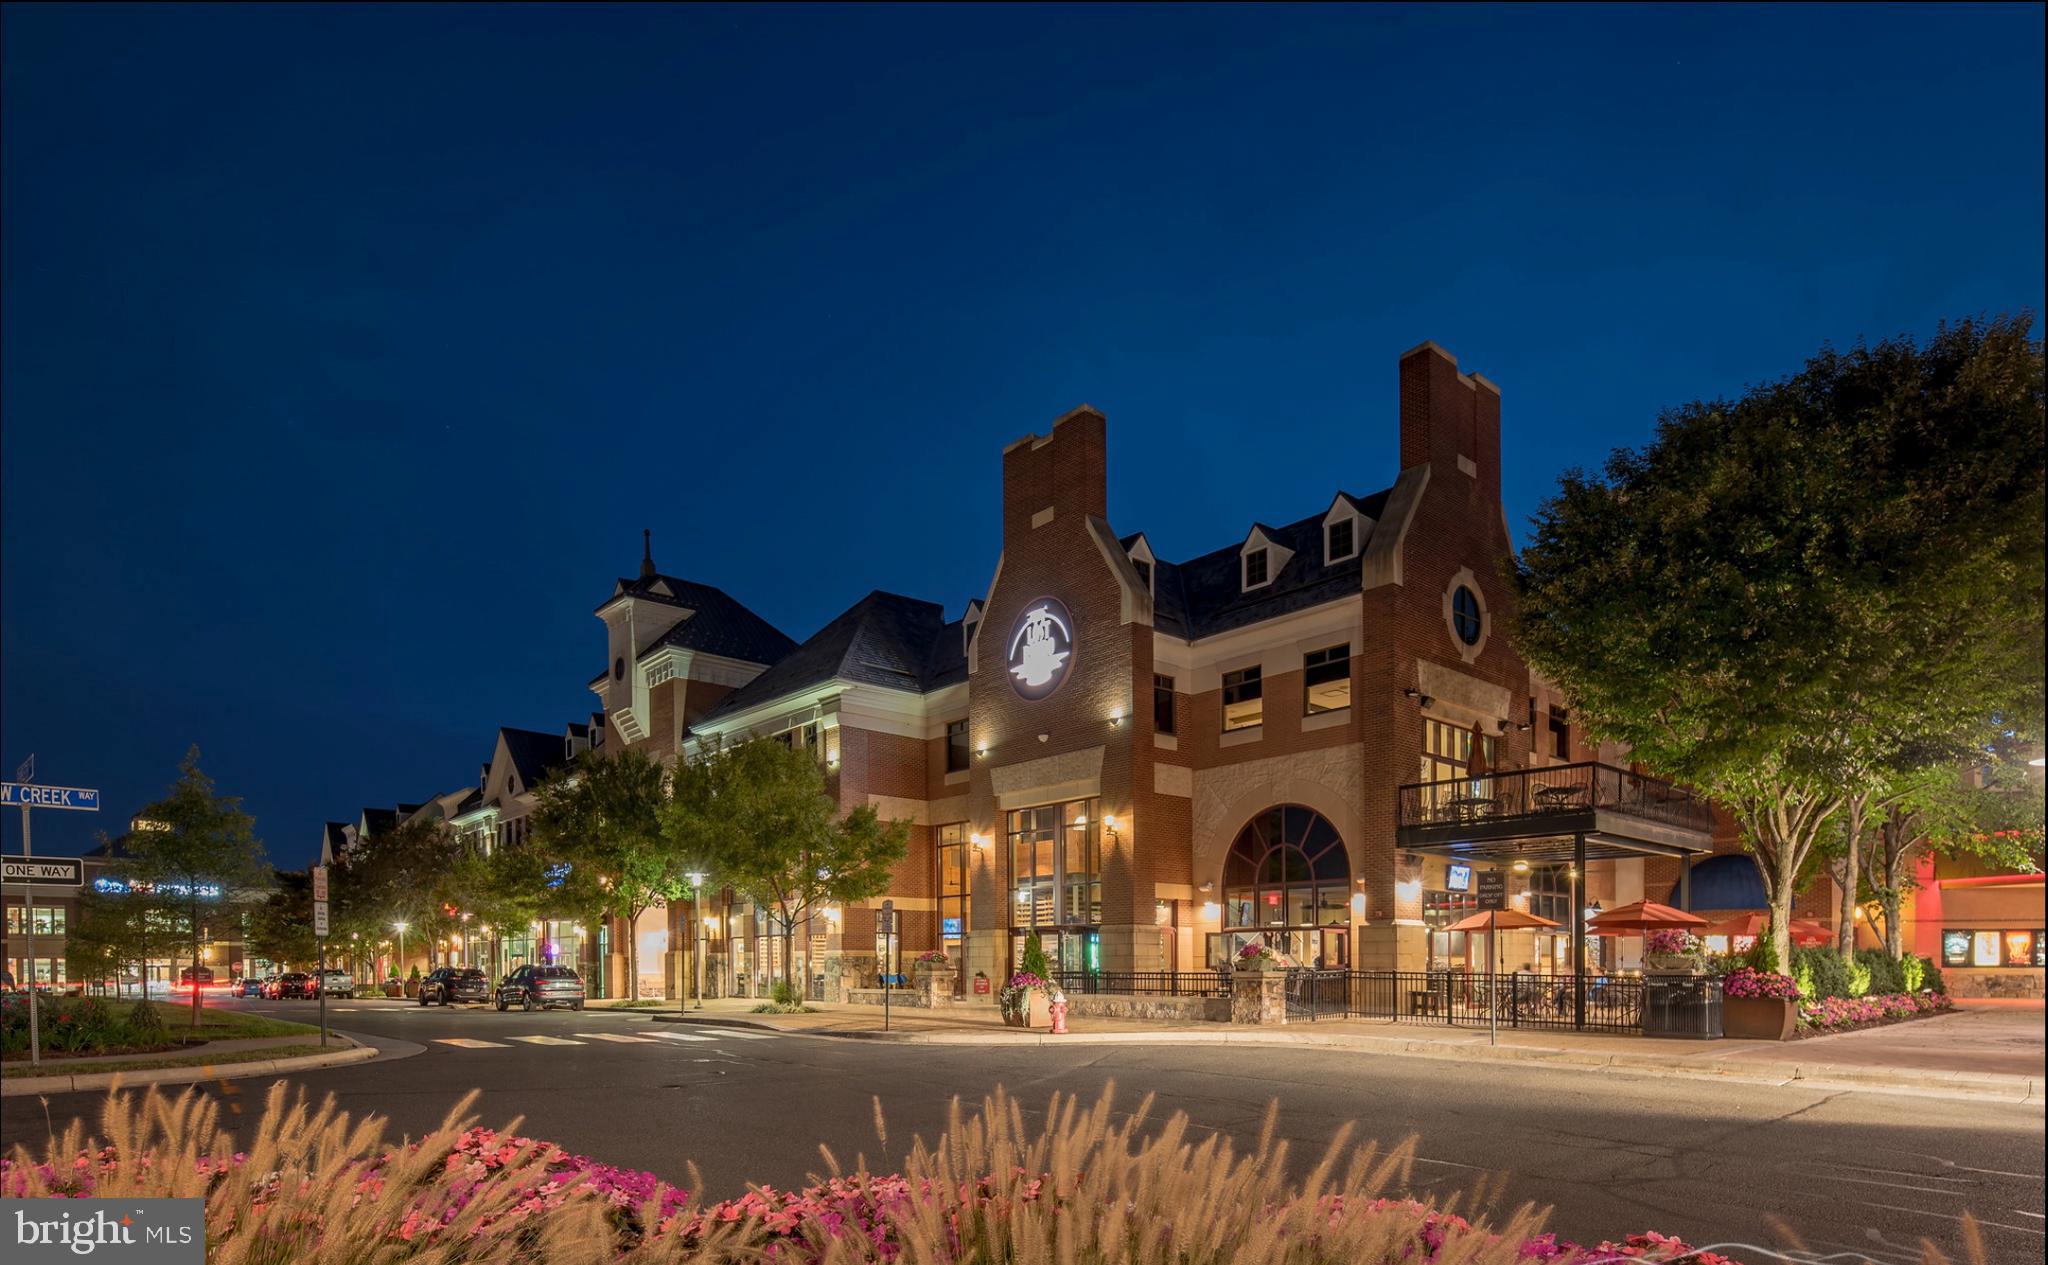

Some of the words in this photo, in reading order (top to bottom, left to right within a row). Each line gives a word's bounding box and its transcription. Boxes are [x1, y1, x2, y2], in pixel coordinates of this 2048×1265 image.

[20, 787, 71, 806] CREEK
[78, 791, 95, 800] WAY
[5, 864, 35, 876] ONE
[40, 866, 70, 877] WAY
